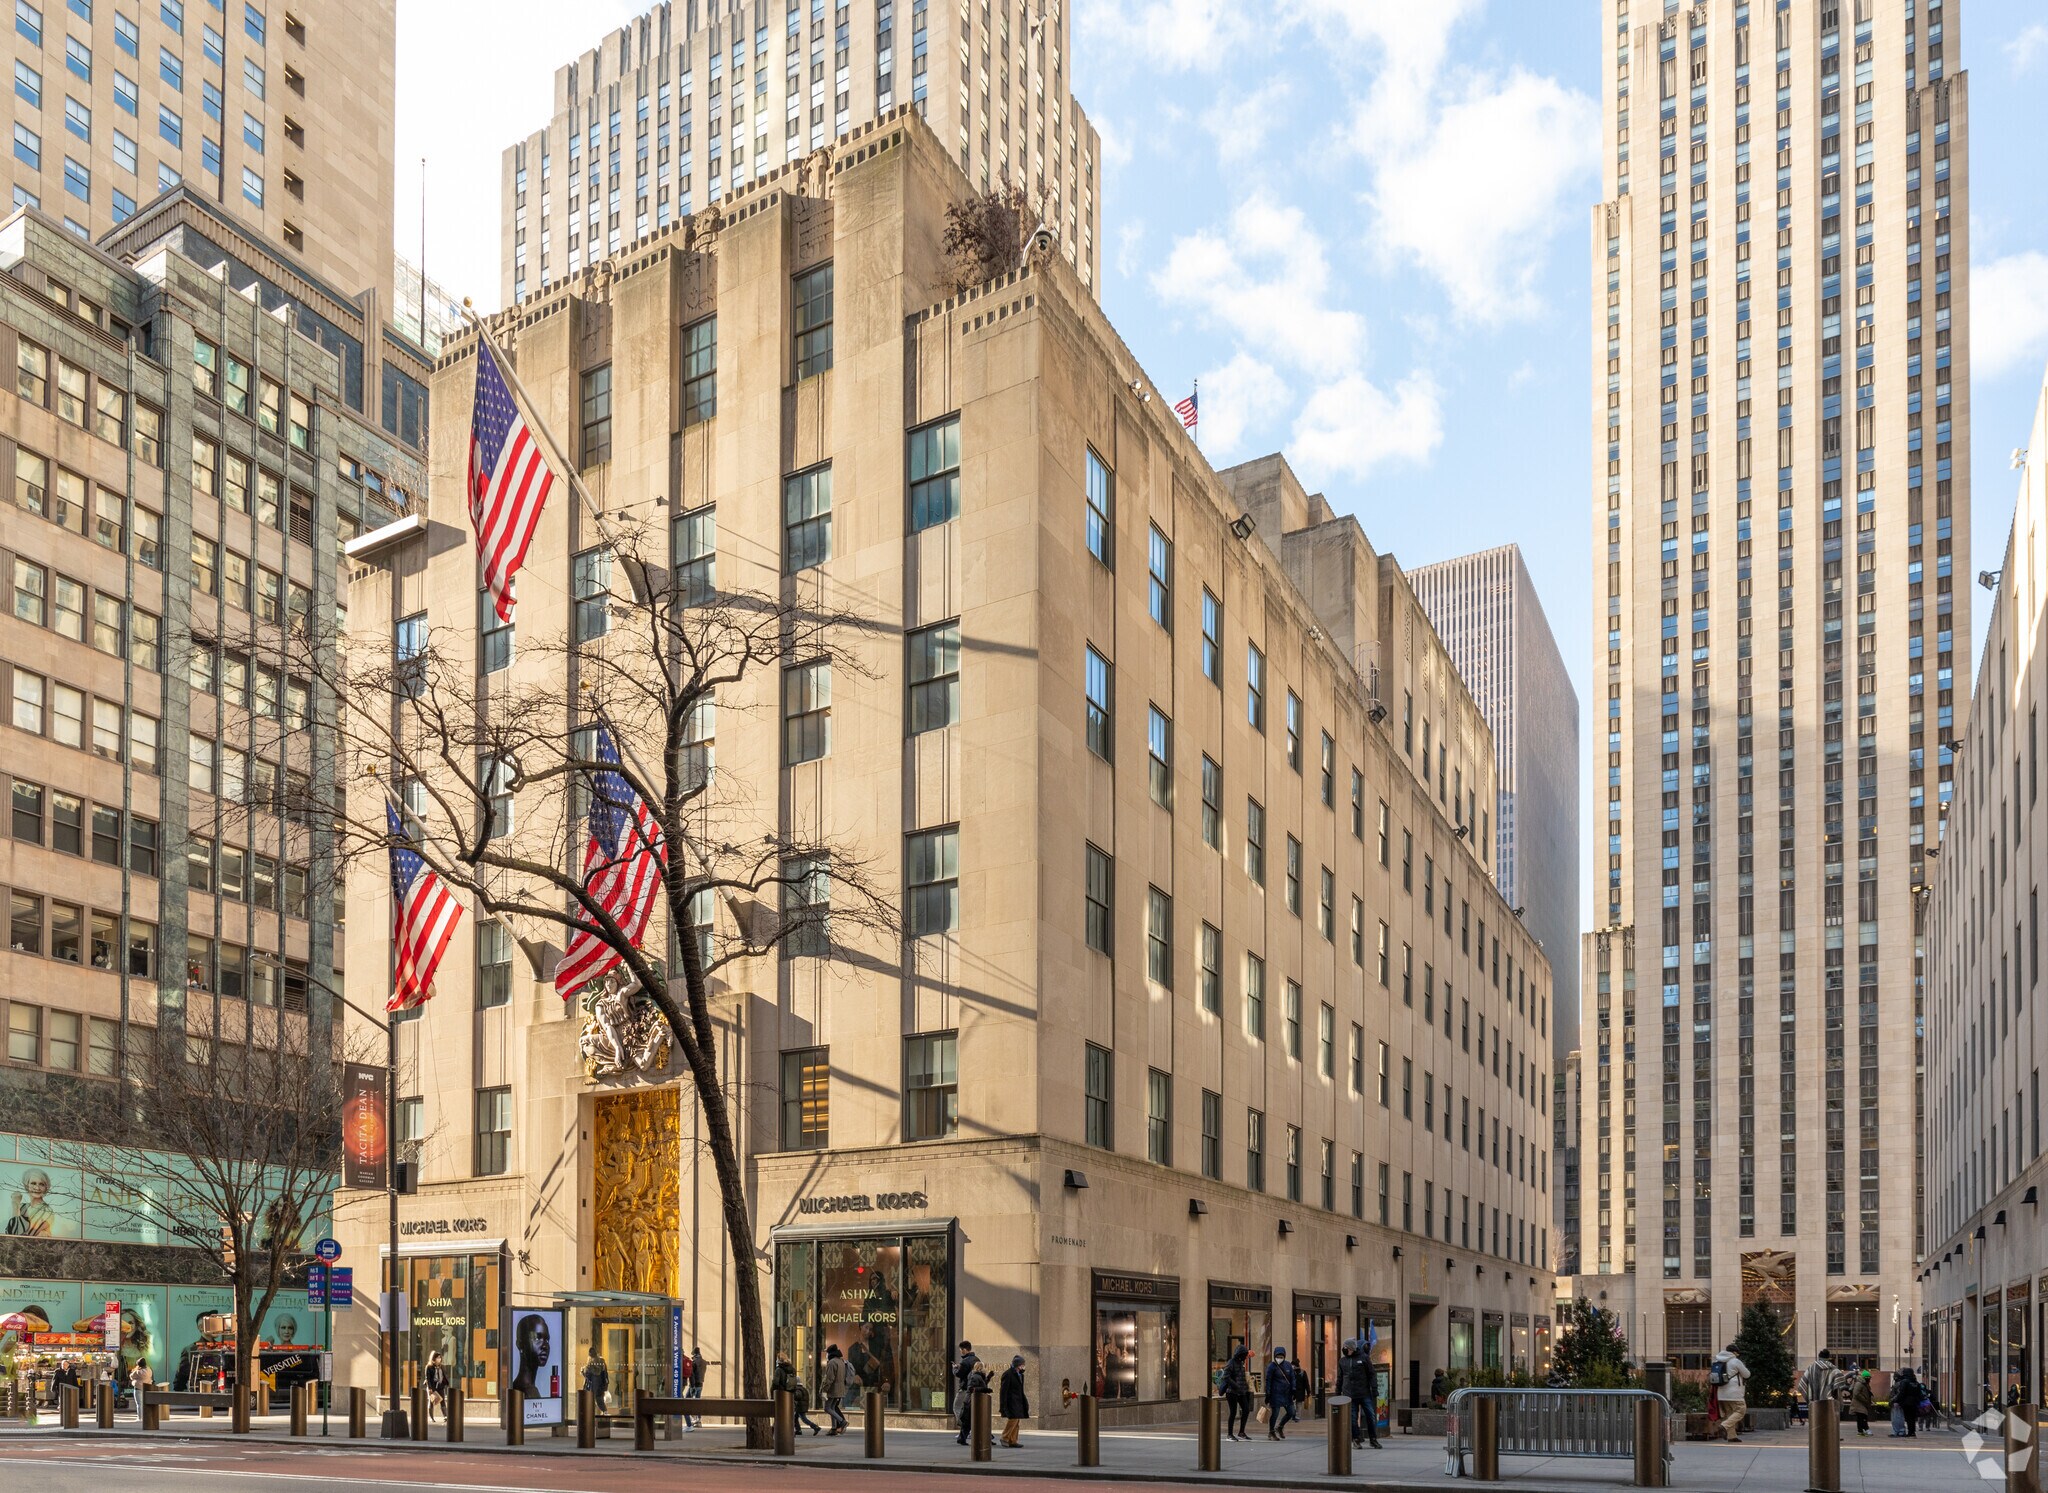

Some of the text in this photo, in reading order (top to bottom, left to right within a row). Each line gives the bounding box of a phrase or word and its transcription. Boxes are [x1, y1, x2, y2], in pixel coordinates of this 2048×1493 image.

[359, 1072, 374, 1081] NYC
[359, 1088, 368, 1165] TACITA DEAN
[800, 1191, 928, 1214] MICHAEL KORS
[400, 1217, 487, 1235] MICHAEL KORS
[1051, 1235, 1087, 1247] PROMENADE
[1102, 1278, 1153, 1294] MICHAEL KORS
[0, 1288, 23, 1299] ND
[840, 1289, 877, 1300] ASHYA
[427, 1298, 452, 1307] ASHYA
[414, 1316, 466, 1326] MICHAEL KORS
[820, 1312, 896, 1323] MICHAEL KORS
[263, 1353, 302, 1376] VERSATILE
[674, 1370, 679, 1378] 49
